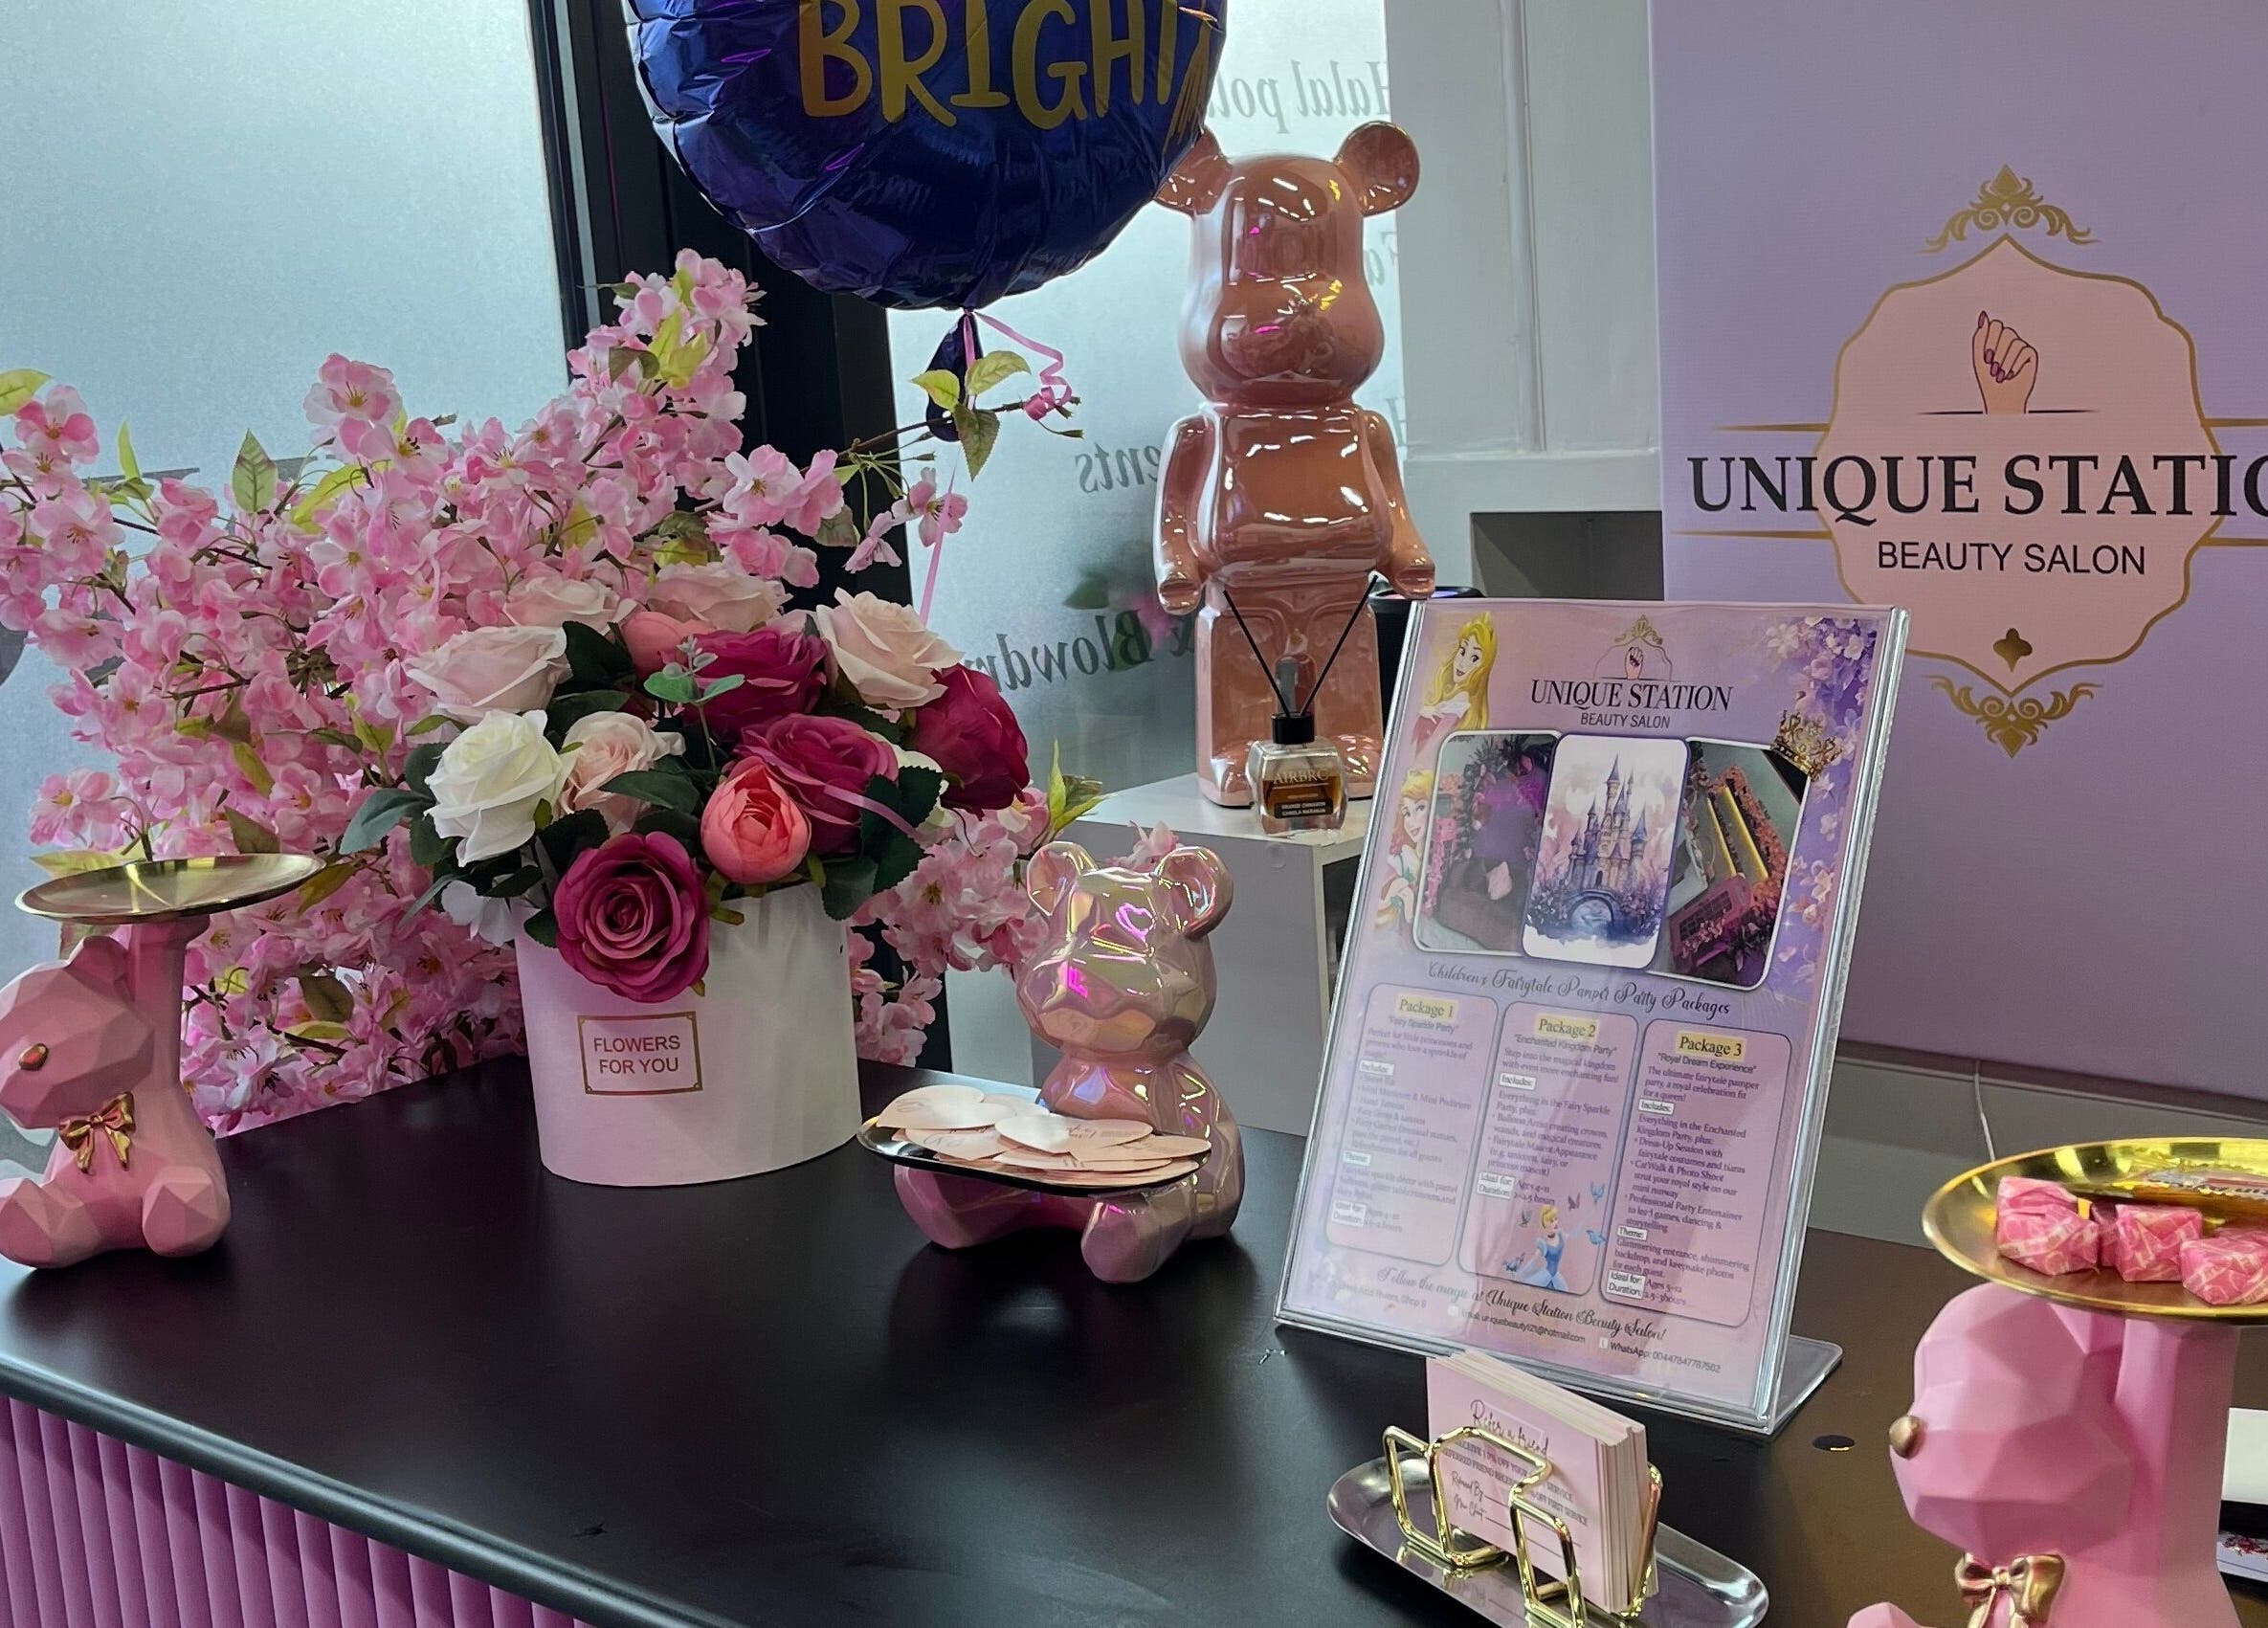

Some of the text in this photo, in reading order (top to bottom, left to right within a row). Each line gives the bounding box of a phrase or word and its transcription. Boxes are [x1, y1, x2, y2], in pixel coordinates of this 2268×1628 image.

[799, 0, 1177, 129] BRIGH
[1687, 455, 1979, 525] UNIQUE
[1879, 542, 2146, 575] BEAUTY SALON
[1527, 680, 1733, 710] UNIQUE STATION
[1580, 713, 1670, 728] BEAUTY SALON
[1399, 999, 1454, 1018] Package 1
[1660, 986, 1731, 1021] Packages
[1538, 1018, 1596, 1038] Package 2
[593, 1036, 680, 1052] FLOWERS
[1679, 1037, 1742, 1057] Package 3
[599, 1058, 678, 1074] FOR YOU
[1657, 1053, 1756, 1074] "Royal Dream Experience"
[1647, 1066, 1759, 1090] The ultimate fairytale pamper
[1635, 1126, 1670, 1138] Kingdom
[1637, 1115, 1745, 1138] Everything in the Enchanted
[1652, 1257, 1667, 1266] and
[1647, 1280, 1664, 1289] Ages
[1483, 1287, 1529, 1317] Unique
[1531, 1298, 1573, 1322] Station
[1574, 1306, 1621, 1338] Beauty
